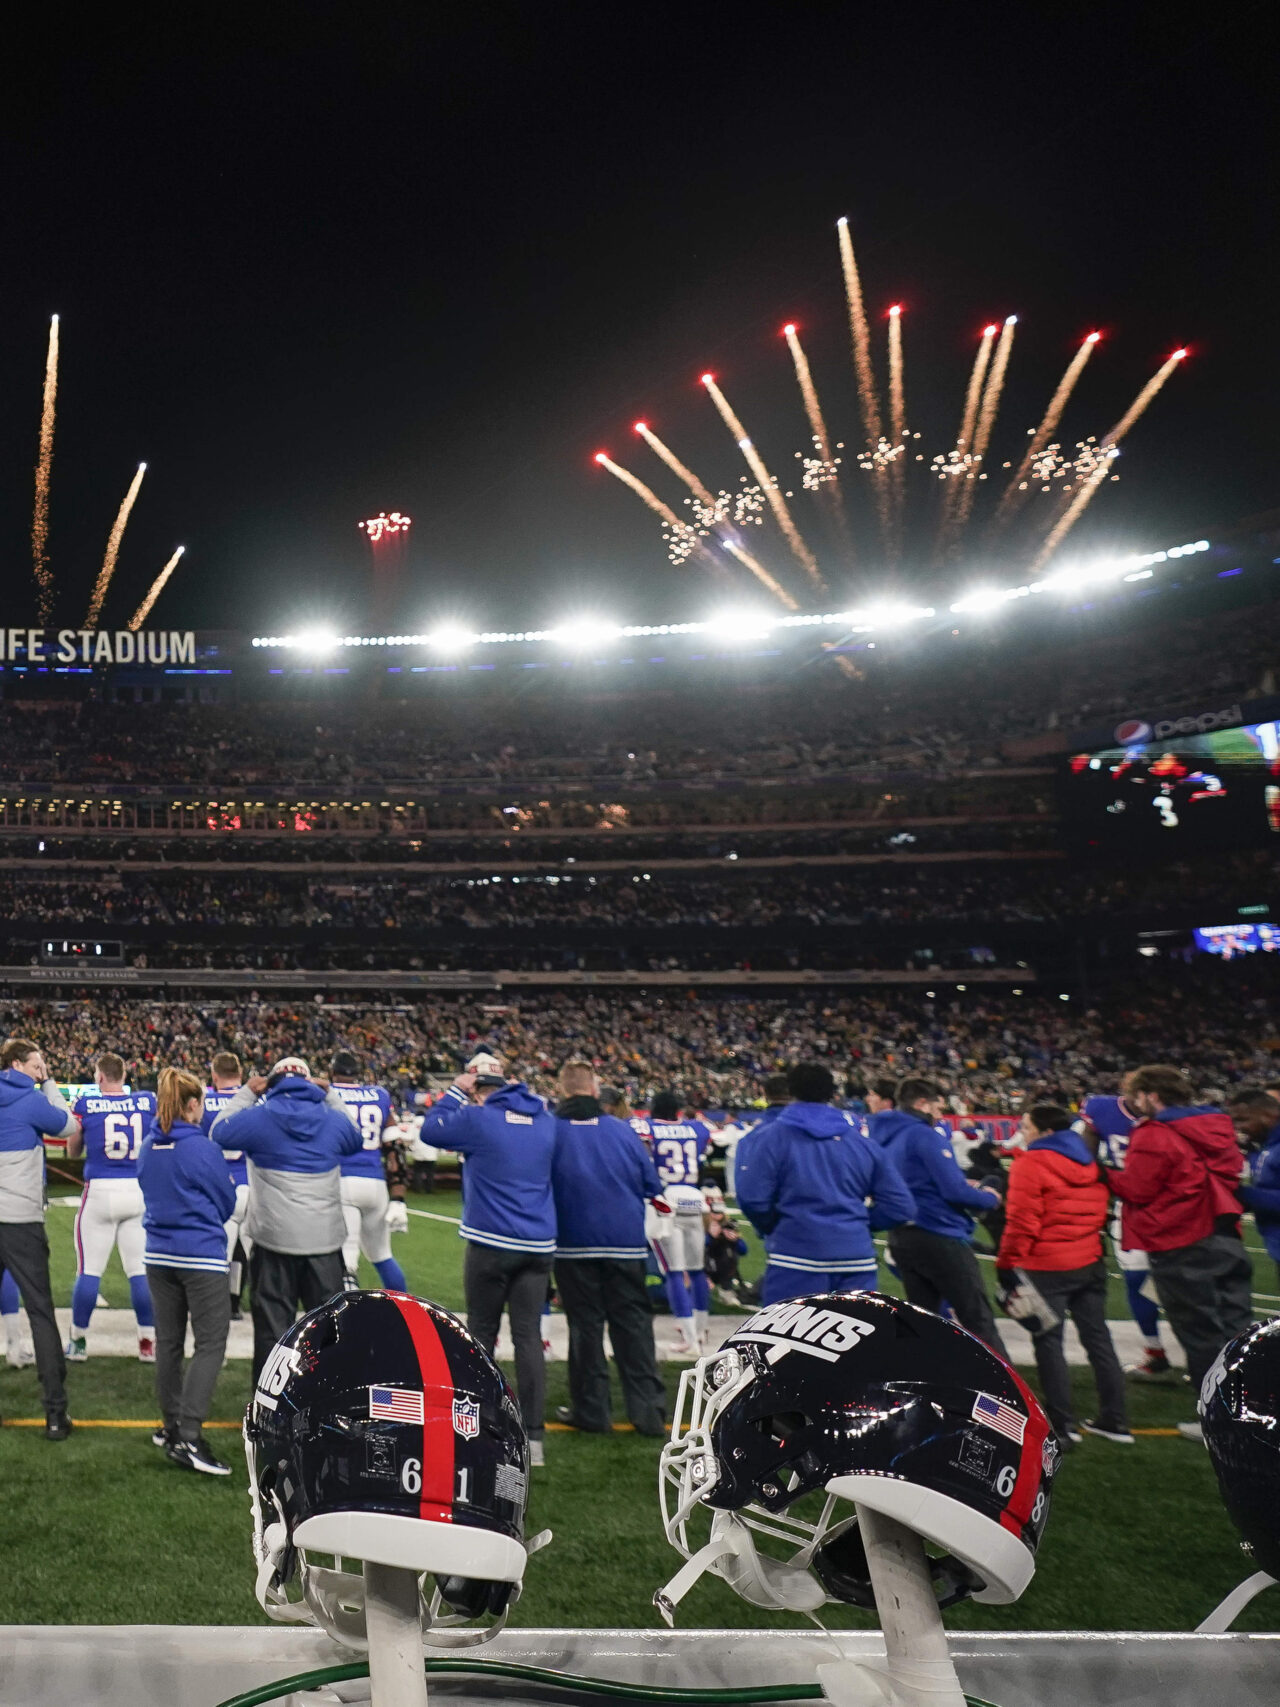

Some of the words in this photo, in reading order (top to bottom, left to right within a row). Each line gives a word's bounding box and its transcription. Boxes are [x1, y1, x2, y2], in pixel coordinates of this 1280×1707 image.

[57, 629, 196, 664] STADIUM
[1154, 704, 1243, 741] pepsi
[86, 1098, 136, 1113] SCHMITZ
[137, 1097, 151, 1111] JR
[105, 1113, 143, 1160] 61
[658, 1140, 699, 1184] 31
[456, 1413, 476, 1433] NFL
